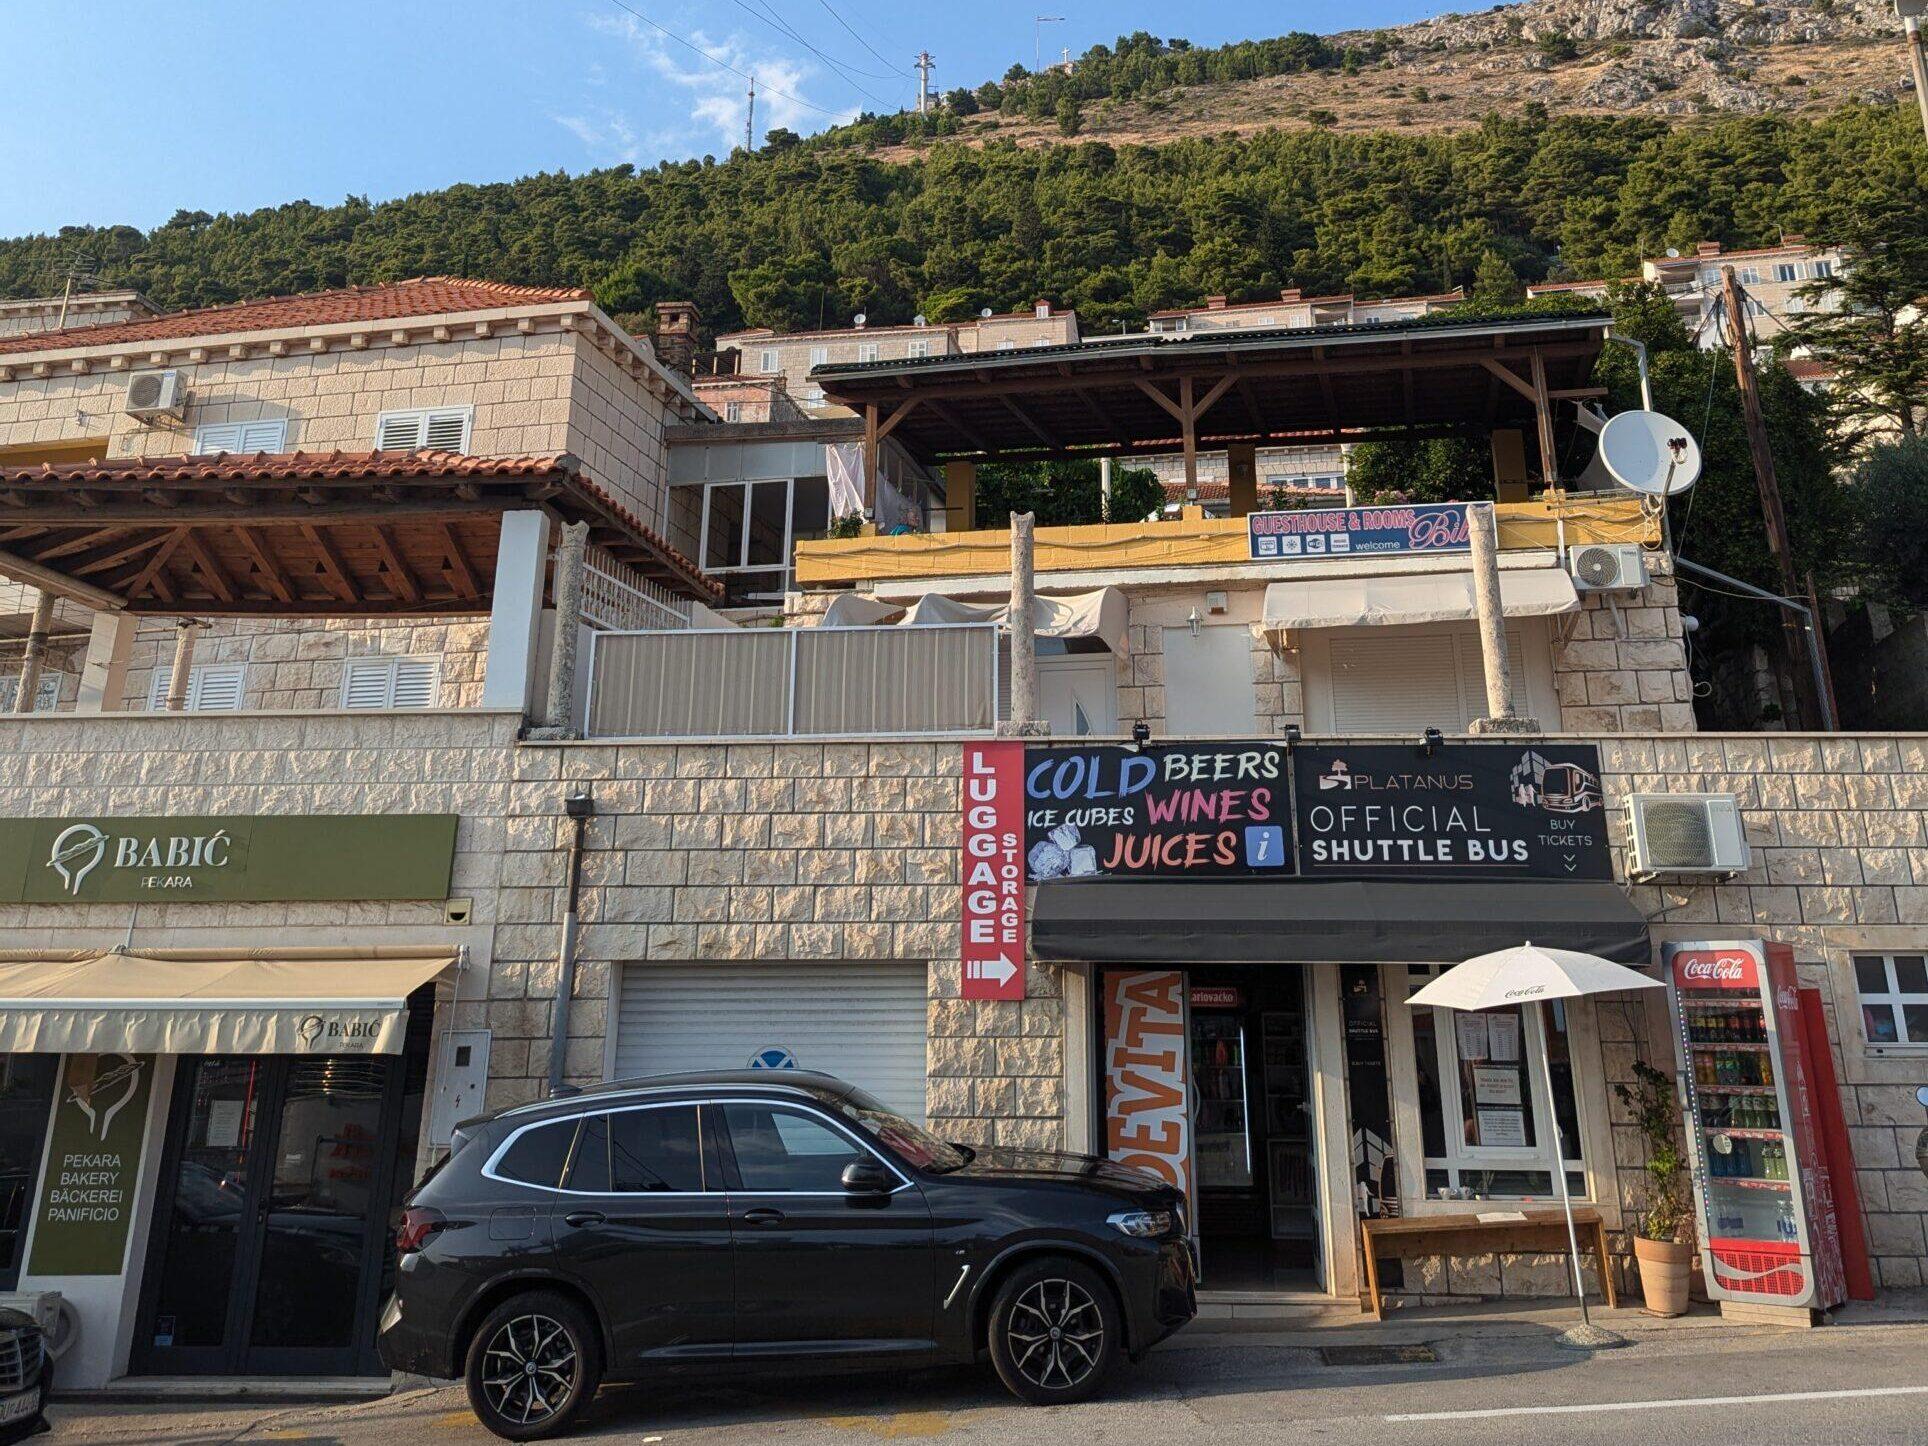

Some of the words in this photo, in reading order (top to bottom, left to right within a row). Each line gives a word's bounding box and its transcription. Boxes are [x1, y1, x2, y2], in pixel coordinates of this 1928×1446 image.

[1252, 512, 1346, 535] GUESTHOUSE
[1349, 511, 1361, 531] &
[1363, 509, 1416, 529] ROOMS
[1408, 510, 1470, 549] Bil
[1355, 540, 1401, 552] welcome
[1026, 755, 1157, 800] COLD
[1163, 751, 1280, 783] BEERS
[1354, 774, 1474, 791] PLATANUS
[1027, 809, 1057, 828] ICE
[1064, 806, 1135, 827] CUBES
[1145, 787, 1271, 827] WINES
[1310, 805, 1492, 833] OFFICIAL
[1550, 819, 1576, 831] BUY
[113, 829, 231, 868] BABIĆ
[967, 752, 997, 943] LUGGAGE
[1103, 830, 1237, 870] JUICES
[1312, 839, 1453, 862] SHUTTLE
[1467, 839, 1529, 861] BUS
[1538, 834, 1593, 847] TICKETS
[141, 876, 194, 889] PEKARA
[1001, 833, 1018, 943] STORAGE
[63, 1153, 121, 1168] PEKARA
[60, 1171, 120, 1186] BAKERY
[50, 1187, 123, 1204] BÄCKEREI
[47, 1206, 119, 1222] PANIFICIO
